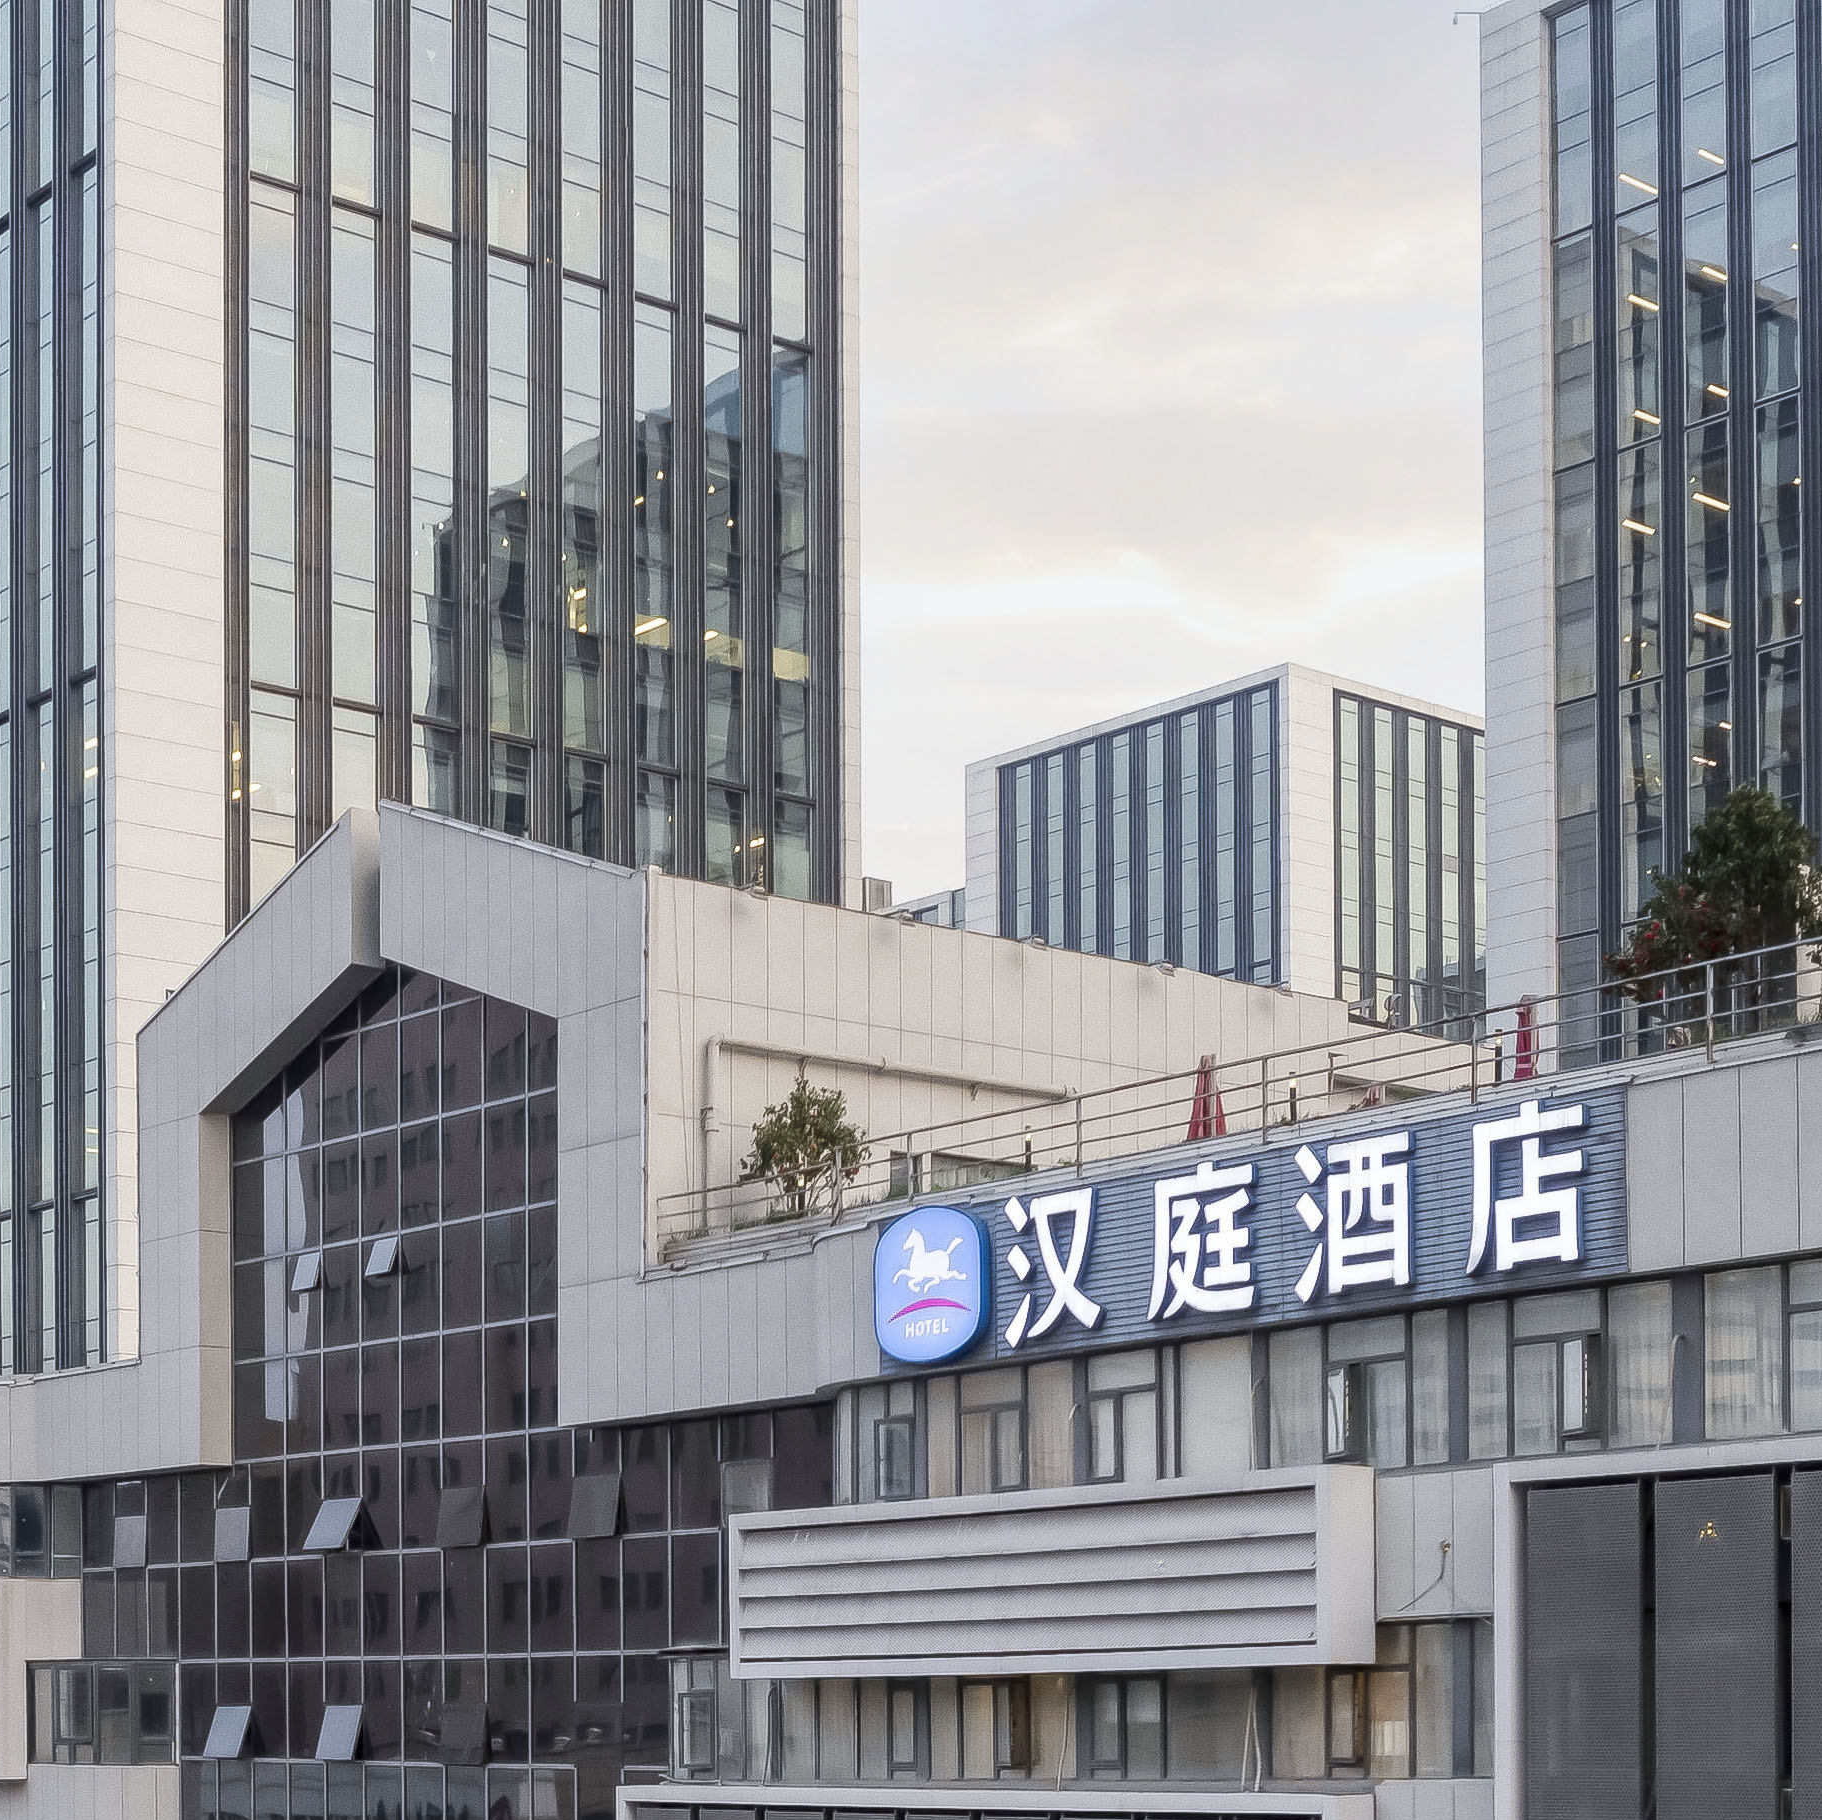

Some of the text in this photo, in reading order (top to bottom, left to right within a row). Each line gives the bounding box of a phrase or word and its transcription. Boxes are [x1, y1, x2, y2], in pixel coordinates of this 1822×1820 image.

[1002, 1099, 1586, 1350] 汉庭酒店
[905, 1317, 950, 1339] HOTEL
